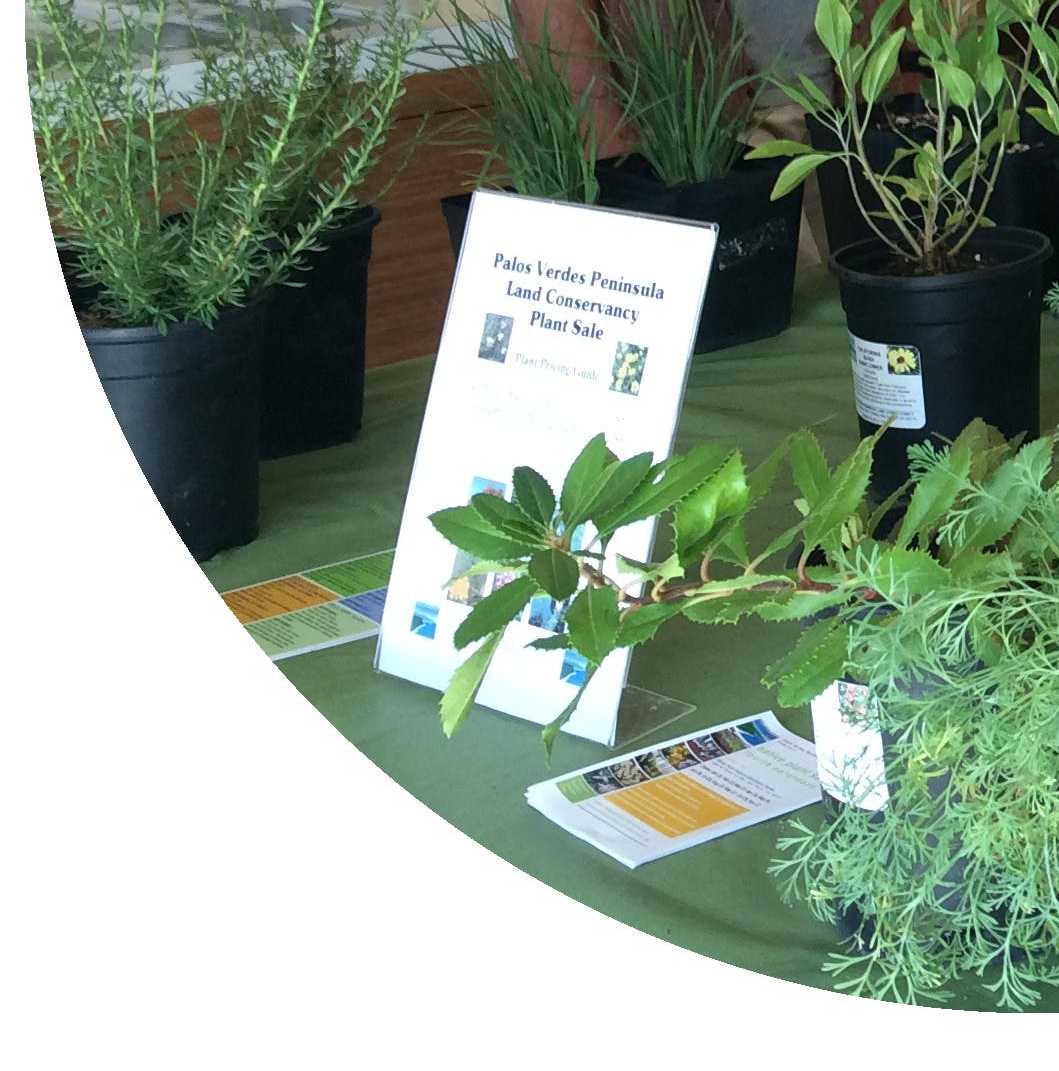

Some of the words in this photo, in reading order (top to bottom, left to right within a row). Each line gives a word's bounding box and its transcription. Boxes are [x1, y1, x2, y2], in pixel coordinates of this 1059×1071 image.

[493, 252, 533, 275] Palos
[537, 260, 587, 285] Verdes
[590, 271, 666, 300] Peninsula
[506, 280, 542, 302] Land
[545, 288, 641, 325] Conservancy
[529, 310, 568, 334] Plant
[571, 318, 605, 341] Sale
[514, 352, 539, 369] Plant
